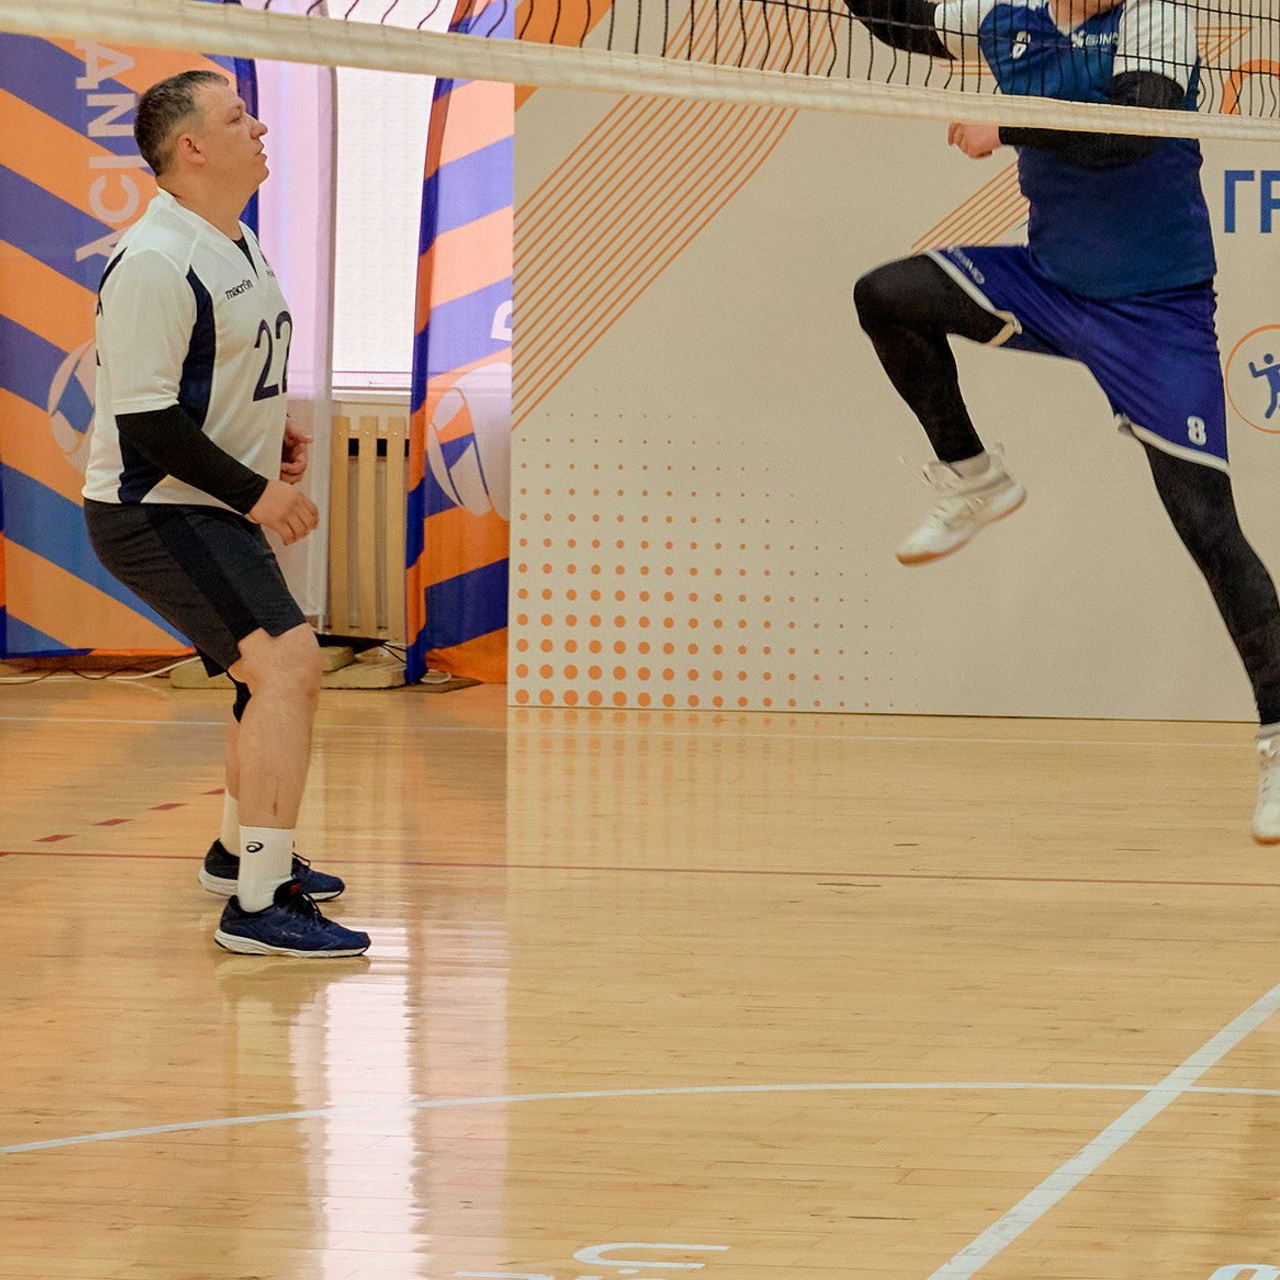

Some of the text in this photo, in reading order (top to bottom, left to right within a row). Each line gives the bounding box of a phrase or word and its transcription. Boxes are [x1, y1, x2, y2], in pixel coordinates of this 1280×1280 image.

[224, 279, 254, 301] macron
[253, 311, 293, 402] 22
[1187, 415, 1207, 447] 8
